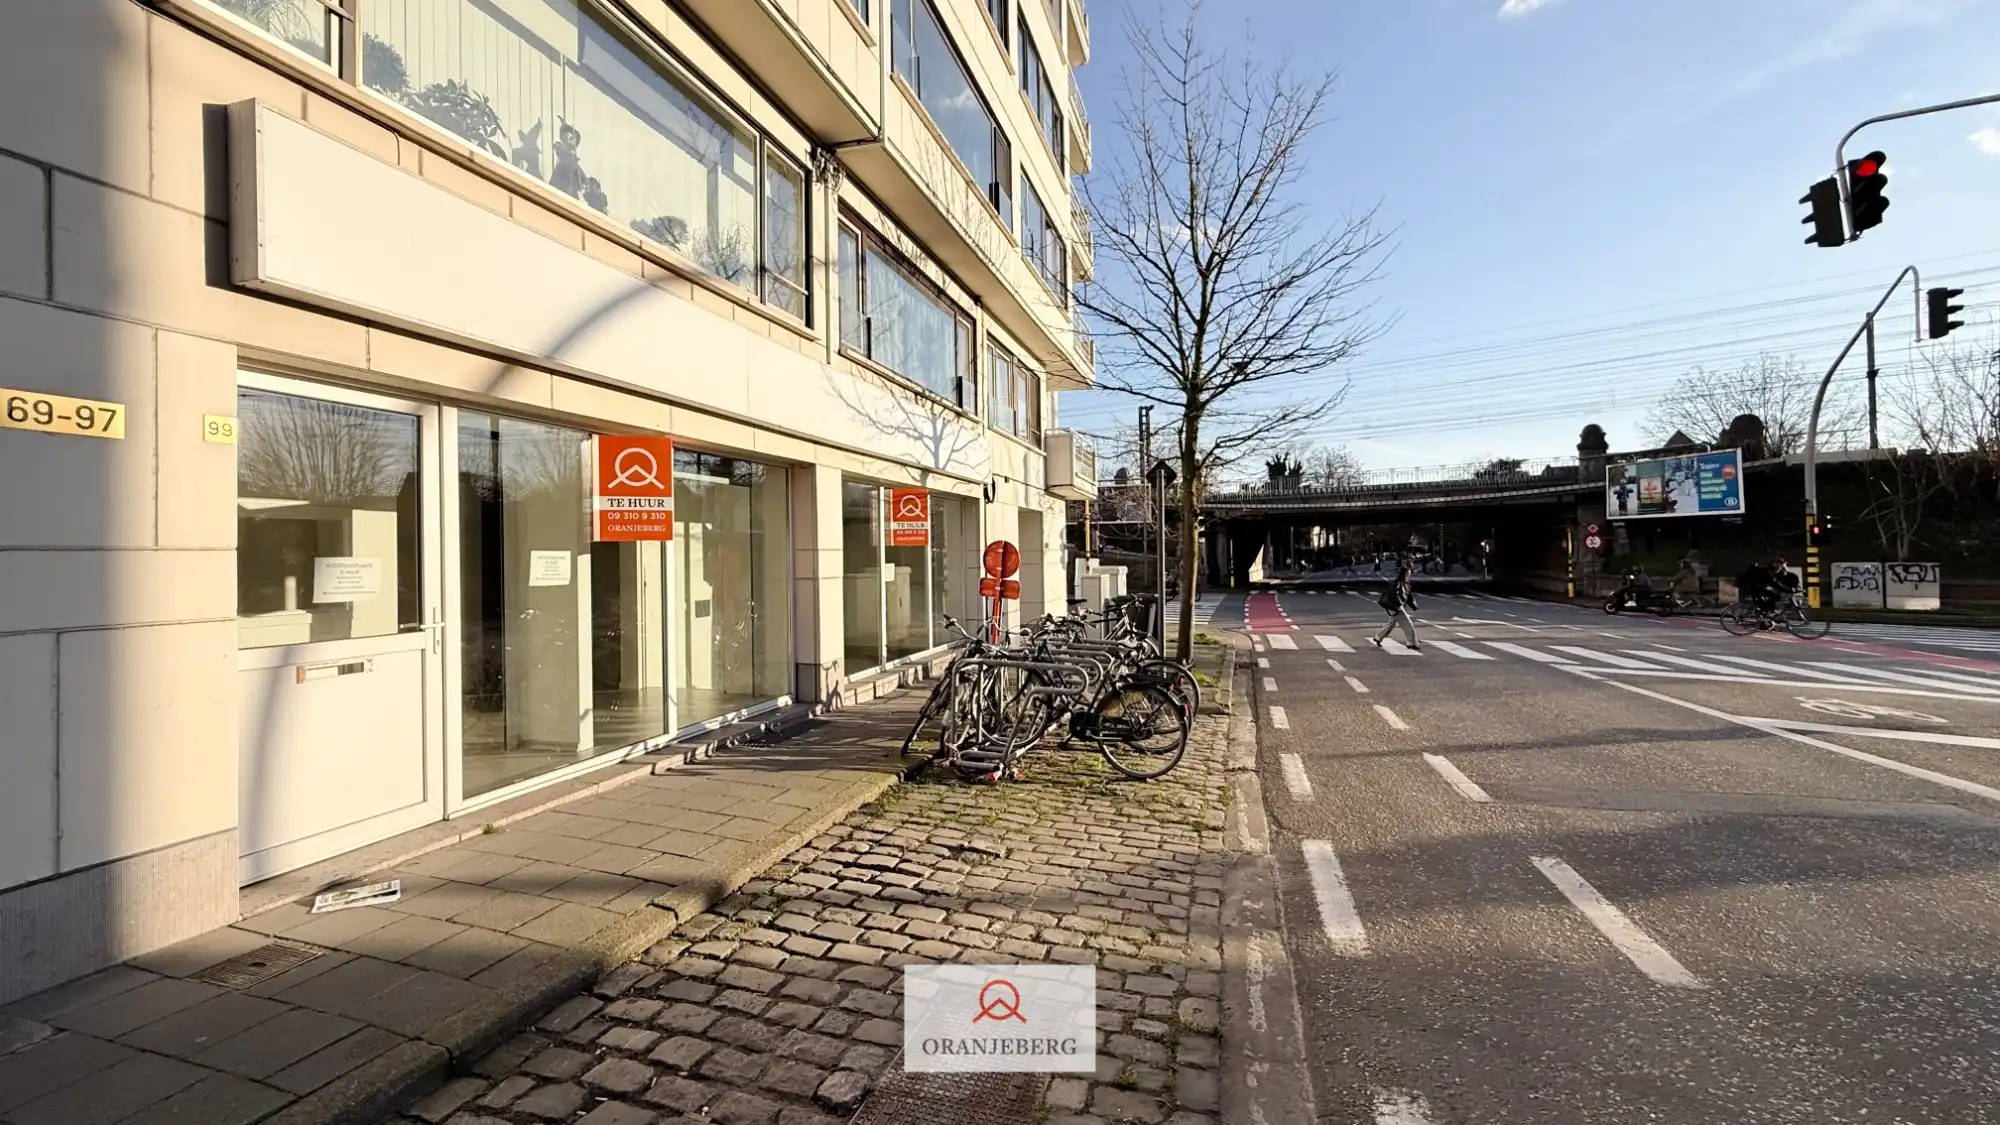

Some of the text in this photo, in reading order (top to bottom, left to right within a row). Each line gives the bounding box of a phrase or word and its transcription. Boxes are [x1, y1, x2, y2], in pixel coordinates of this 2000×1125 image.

[7, 396, 117, 432] 69-97
[208, 421, 233, 437] 99
[607, 498, 665, 508] TE HUUR
[607, 512, 666, 520] 09 310 9 310
[607, 524, 666, 532] ORANJEBERG
